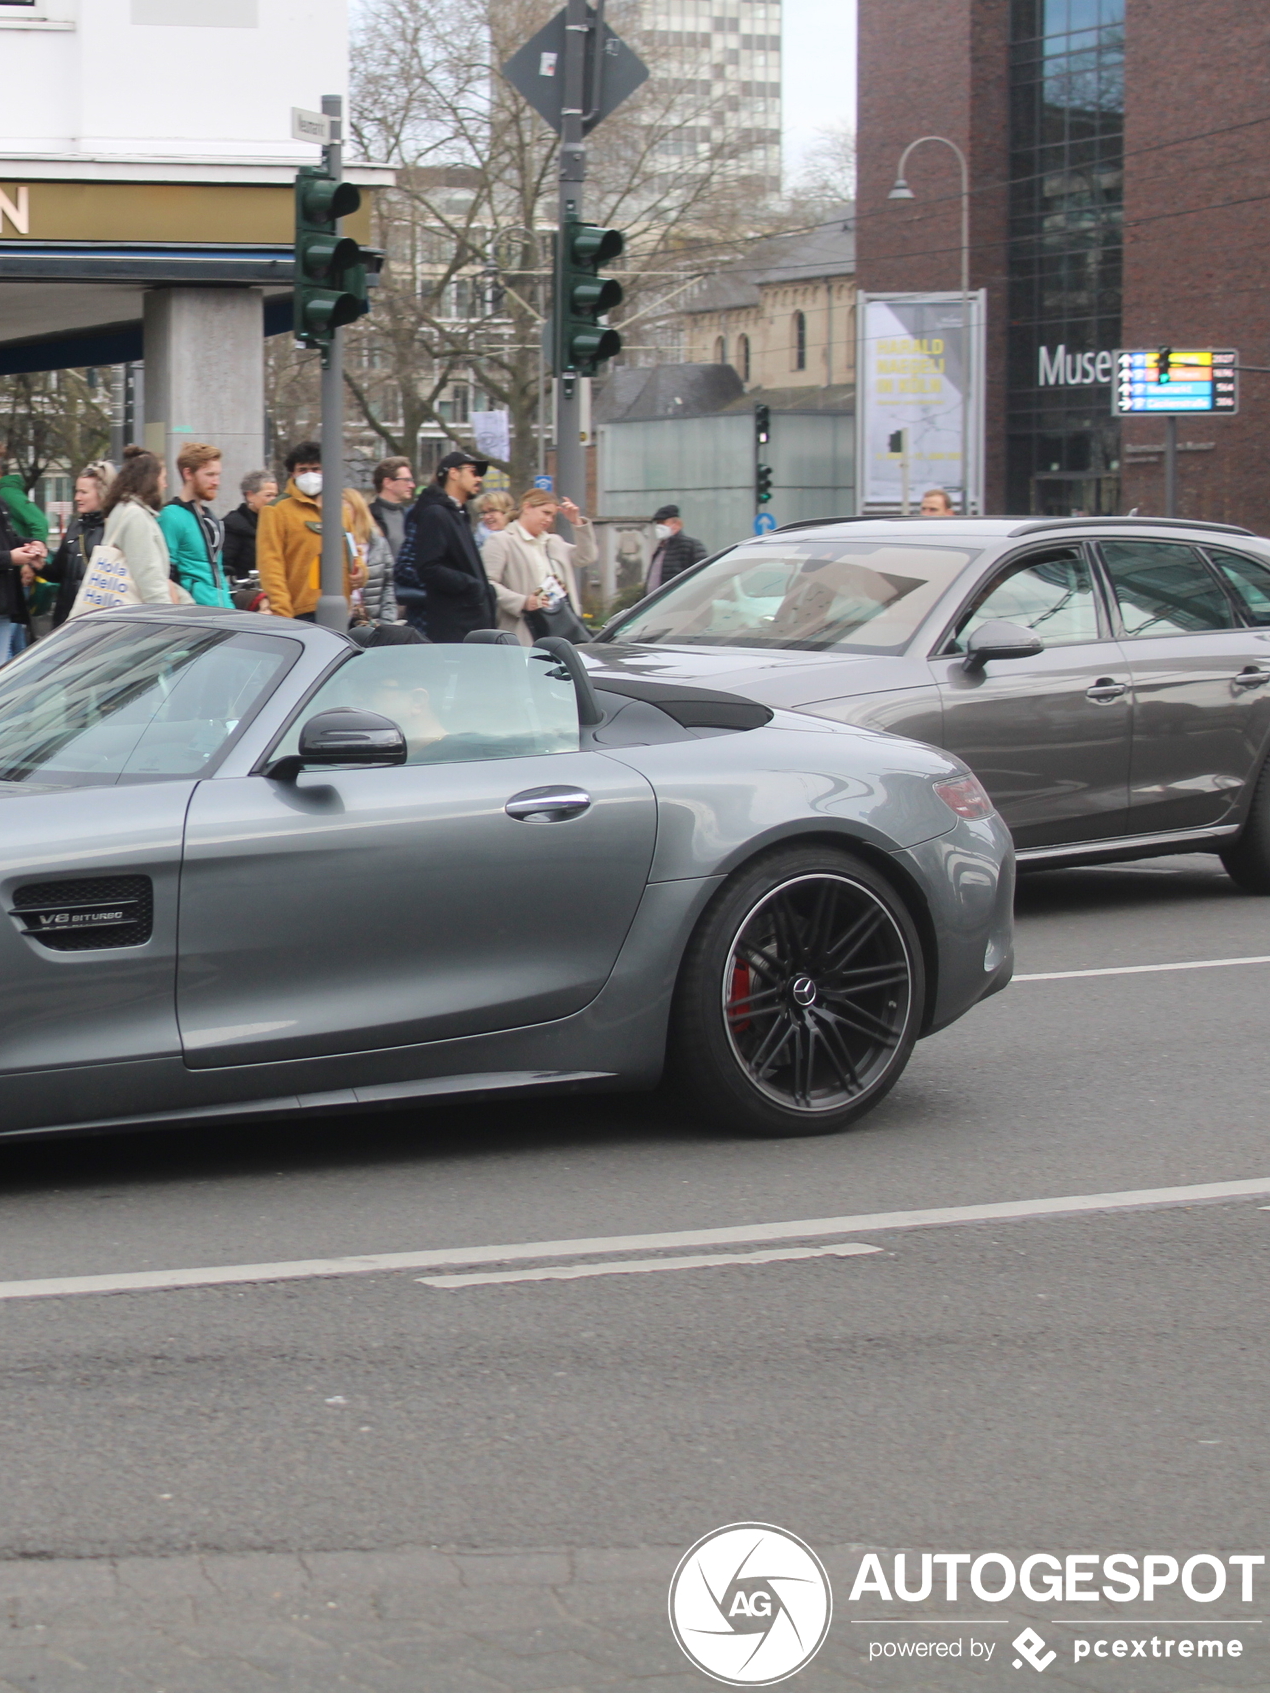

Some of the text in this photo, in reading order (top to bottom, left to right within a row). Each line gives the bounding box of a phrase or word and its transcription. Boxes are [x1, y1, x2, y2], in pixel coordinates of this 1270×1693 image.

[876, 338, 945, 355] HARALD
[876, 358, 946, 374] NAEGELI
[898, 374, 942, 393] KÖLN
[94, 557, 126, 577] Hola
[88, 572, 128, 593] Hello
[39, 911, 123, 925] V8 BITURBO
